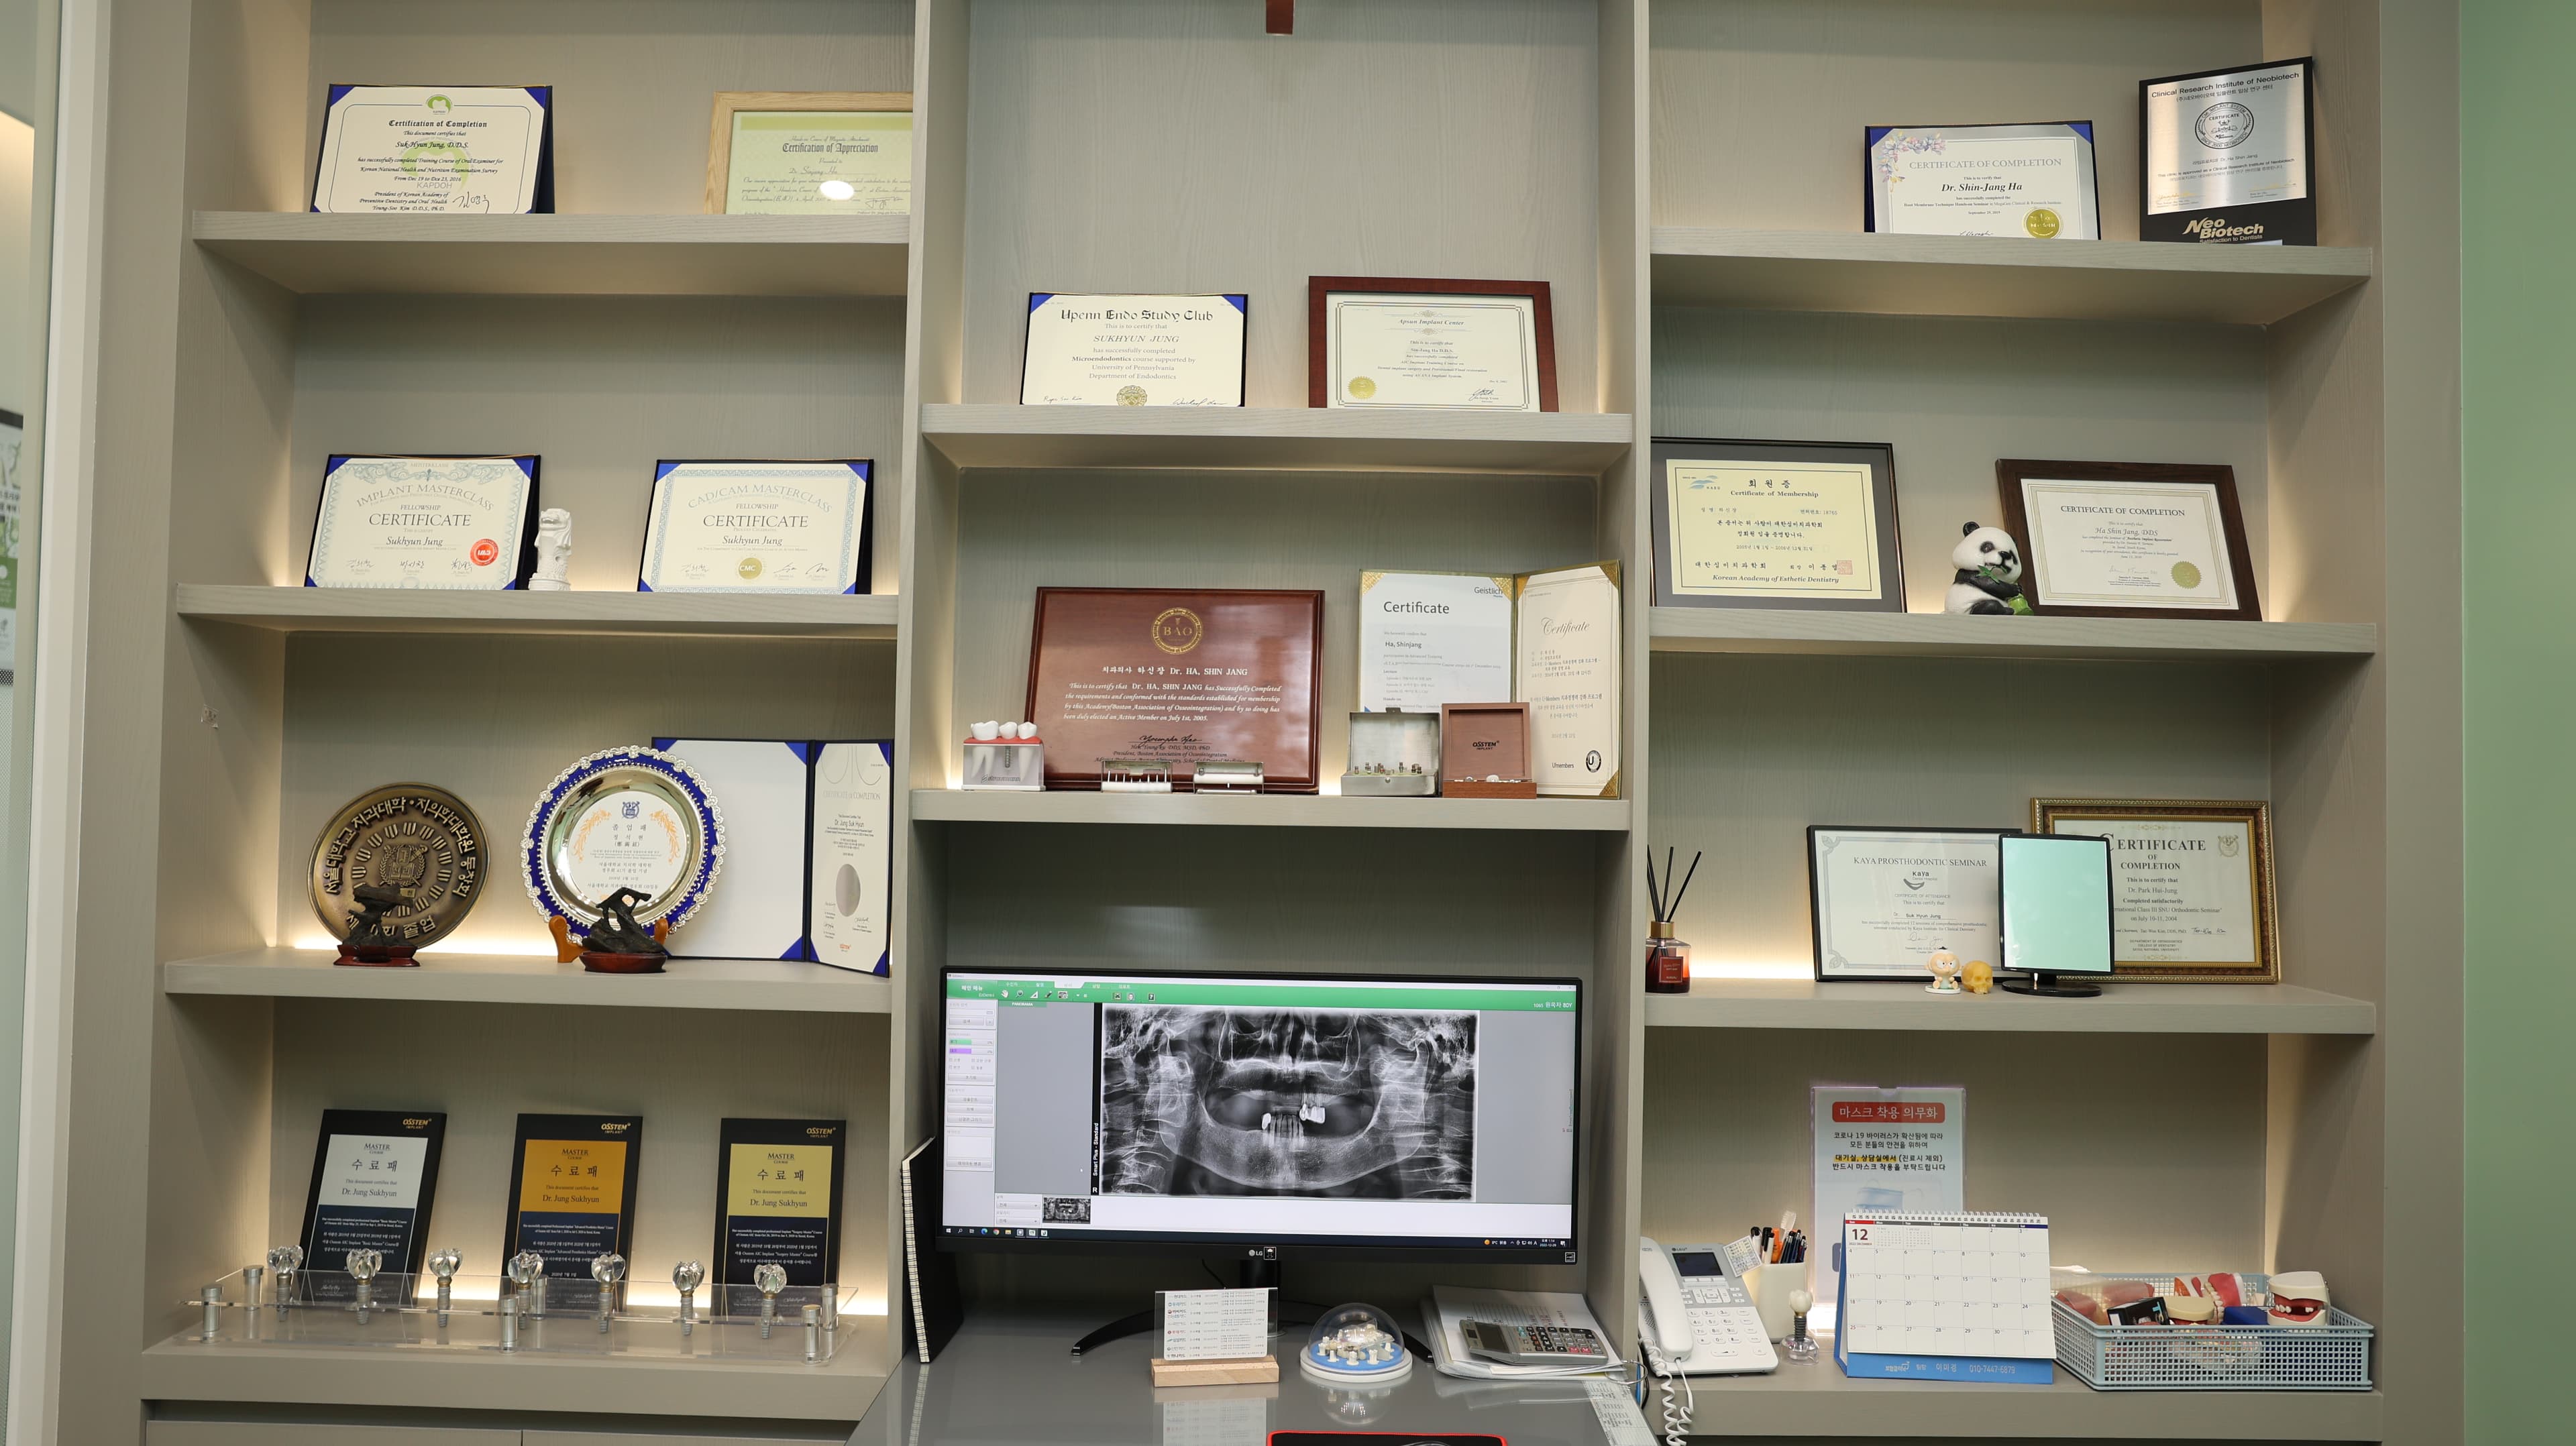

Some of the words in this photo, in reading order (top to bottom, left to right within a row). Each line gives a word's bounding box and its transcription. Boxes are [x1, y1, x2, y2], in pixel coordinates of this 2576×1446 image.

[2151, 89, 2176, 97] Clinical
[2180, 84, 2213, 94] Research
[2216, 79, 2243, 89] Institute
[2256, 72, 2298, 83] Neobiotech
[2208, 111, 2241, 120] CERTIFICATE
[395, 140, 429, 149] Suk-Hyun
[782, 142, 824, 152] Certification
[826, 143, 834, 153] of
[835, 143, 877, 154] Appreciation
[1909, 160, 1975, 168] CERTIFICATE
[1992, 158, 2061, 167] COMPLETION
[1959, 183, 2005, 192] Shin-Jang
[2182, 217, 2225, 235] Neo
[2200, 223, 2263, 239] Biotech
[2199, 236, 2231, 244] Satisfaction
[1061, 309, 1099, 322] Upenn
[1106, 310, 1137, 319] Endo
[1141, 310, 1179, 322] Study
[1184, 310, 1212, 320] Club
[356, 484, 414, 506] IMPLANT
[417, 484, 494, 510] MASTERCLASS
[688, 485, 748, 508] CAD/CAM
[752, 484, 833, 513] MASTERCLASS
[2129, 508, 2184, 516] COMPLETION
[369, 514, 470, 526] CERTIFICATE
[703, 515, 808, 527] CERTIFICATE
[386, 536, 421, 547] Sukhyun
[423, 537, 443, 548] Jung
[722, 535, 759, 546] Sukhyun
[761, 536, 782, 546] Jung
[1383, 600, 1449, 614] Certificate
[1163, 626, 1194, 636] BAO
[1542, 617, 1590, 638] Certificate
[1840, 1105, 1873, 1118] 마스크
[1877, 1106, 1899, 1119] 착용
[1903, 1106, 1937, 1119] 의무화
[402, 1119, 428, 1127] OSSTEM
[601, 1123, 628, 1131] OSSTEM
[806, 1127, 832, 1135] OSSTEM
[1925, 1154, 1942, 1162] 제외)
[353, 1188, 368, 1197] Jung
[369, 1188, 396, 1198] Sukhyun
[553, 1194, 569, 1203] Jung
[571, 1195, 598, 1204] Sukhyun
[761, 1199, 777, 1207] Jung
[779, 1199, 807, 1208] Sukhyun
[1852, 1229, 1868, 1240] 12
[1970, 1365, 2015, 1374] 010-7447-6879
